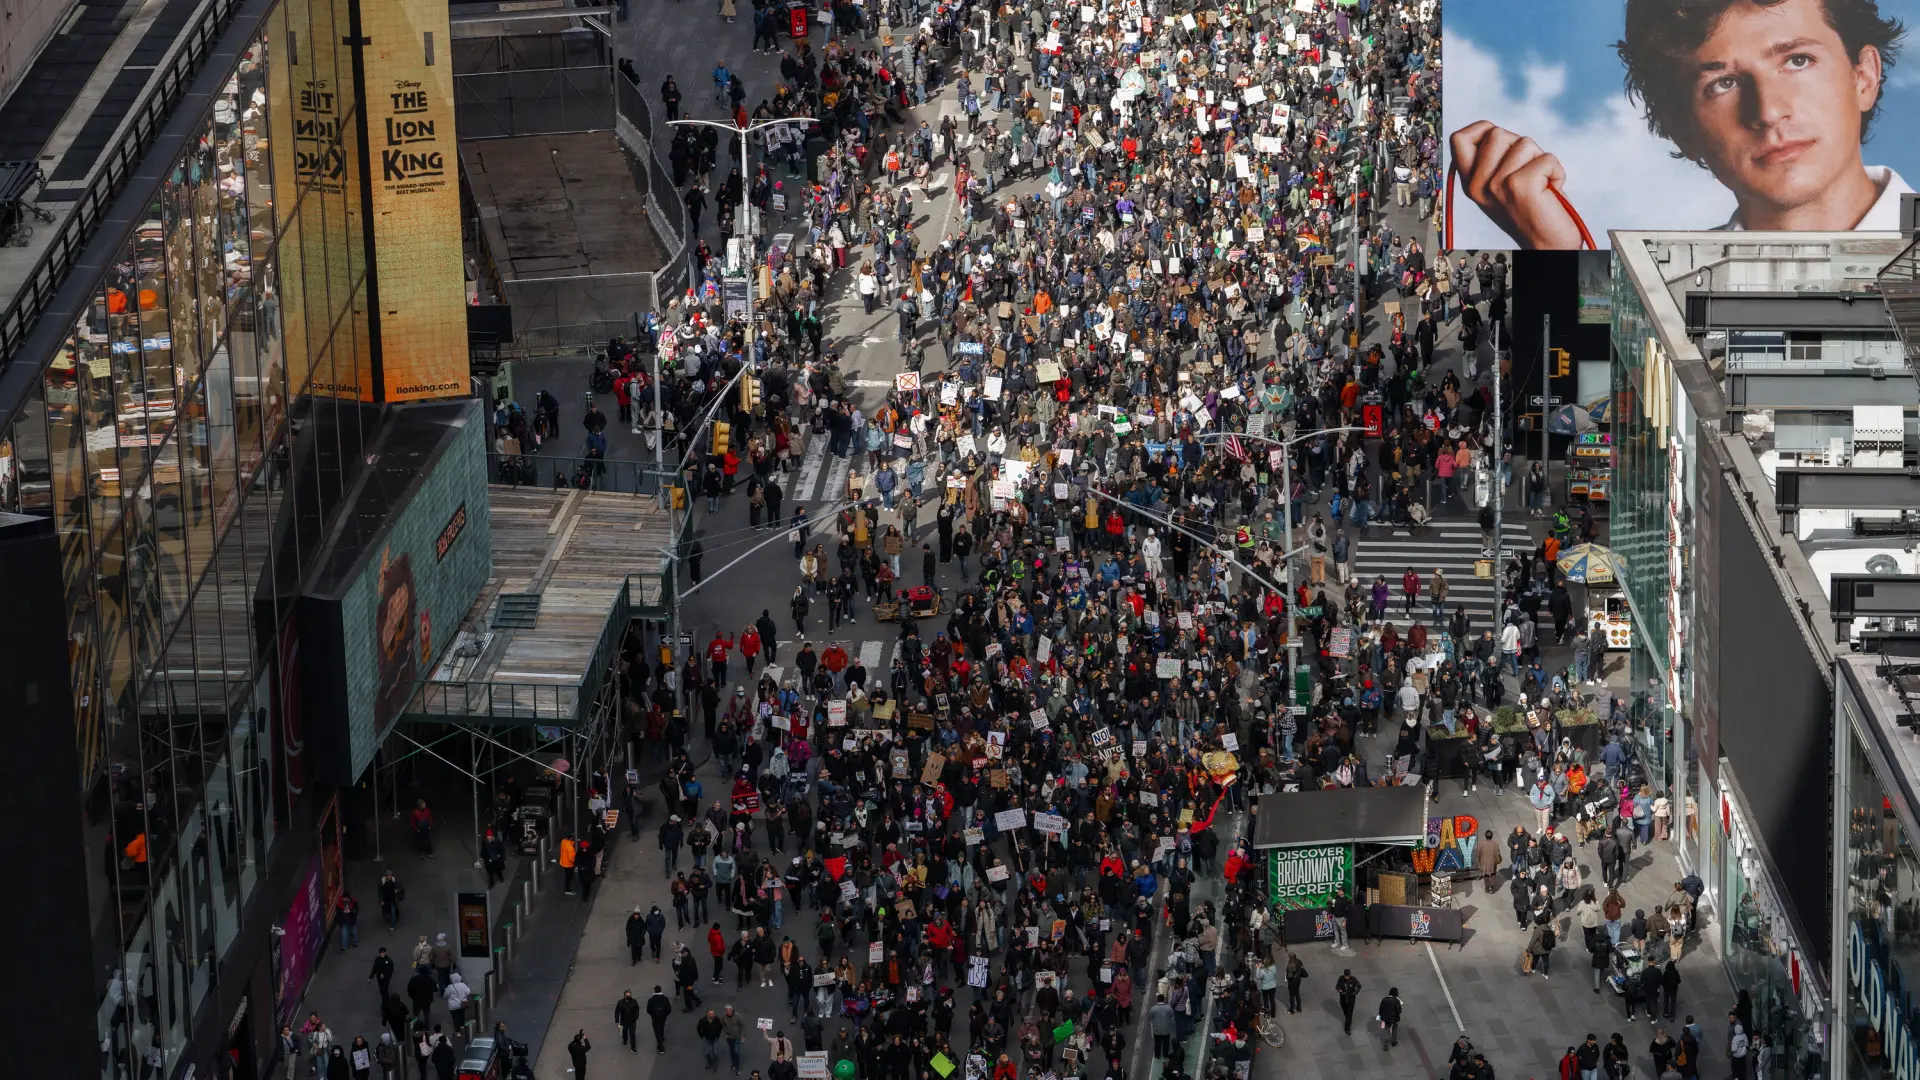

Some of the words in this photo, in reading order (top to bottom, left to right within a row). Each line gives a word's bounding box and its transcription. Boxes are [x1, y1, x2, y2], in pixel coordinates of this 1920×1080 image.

[390, 91, 428, 108] THE
[385, 117, 436, 146] LION
[382, 149, 444, 181] KING
[397, 180, 446, 190] AWARD-WINNING
[396, 382, 460, 394] lionking.com
[1700, 619, 1710, 756] NOW
[1277, 846, 1344, 860] DISCOVER
[1277, 855, 1345, 887] BROADWAY'S
[1850, 920, 1885, 1033] OLD
